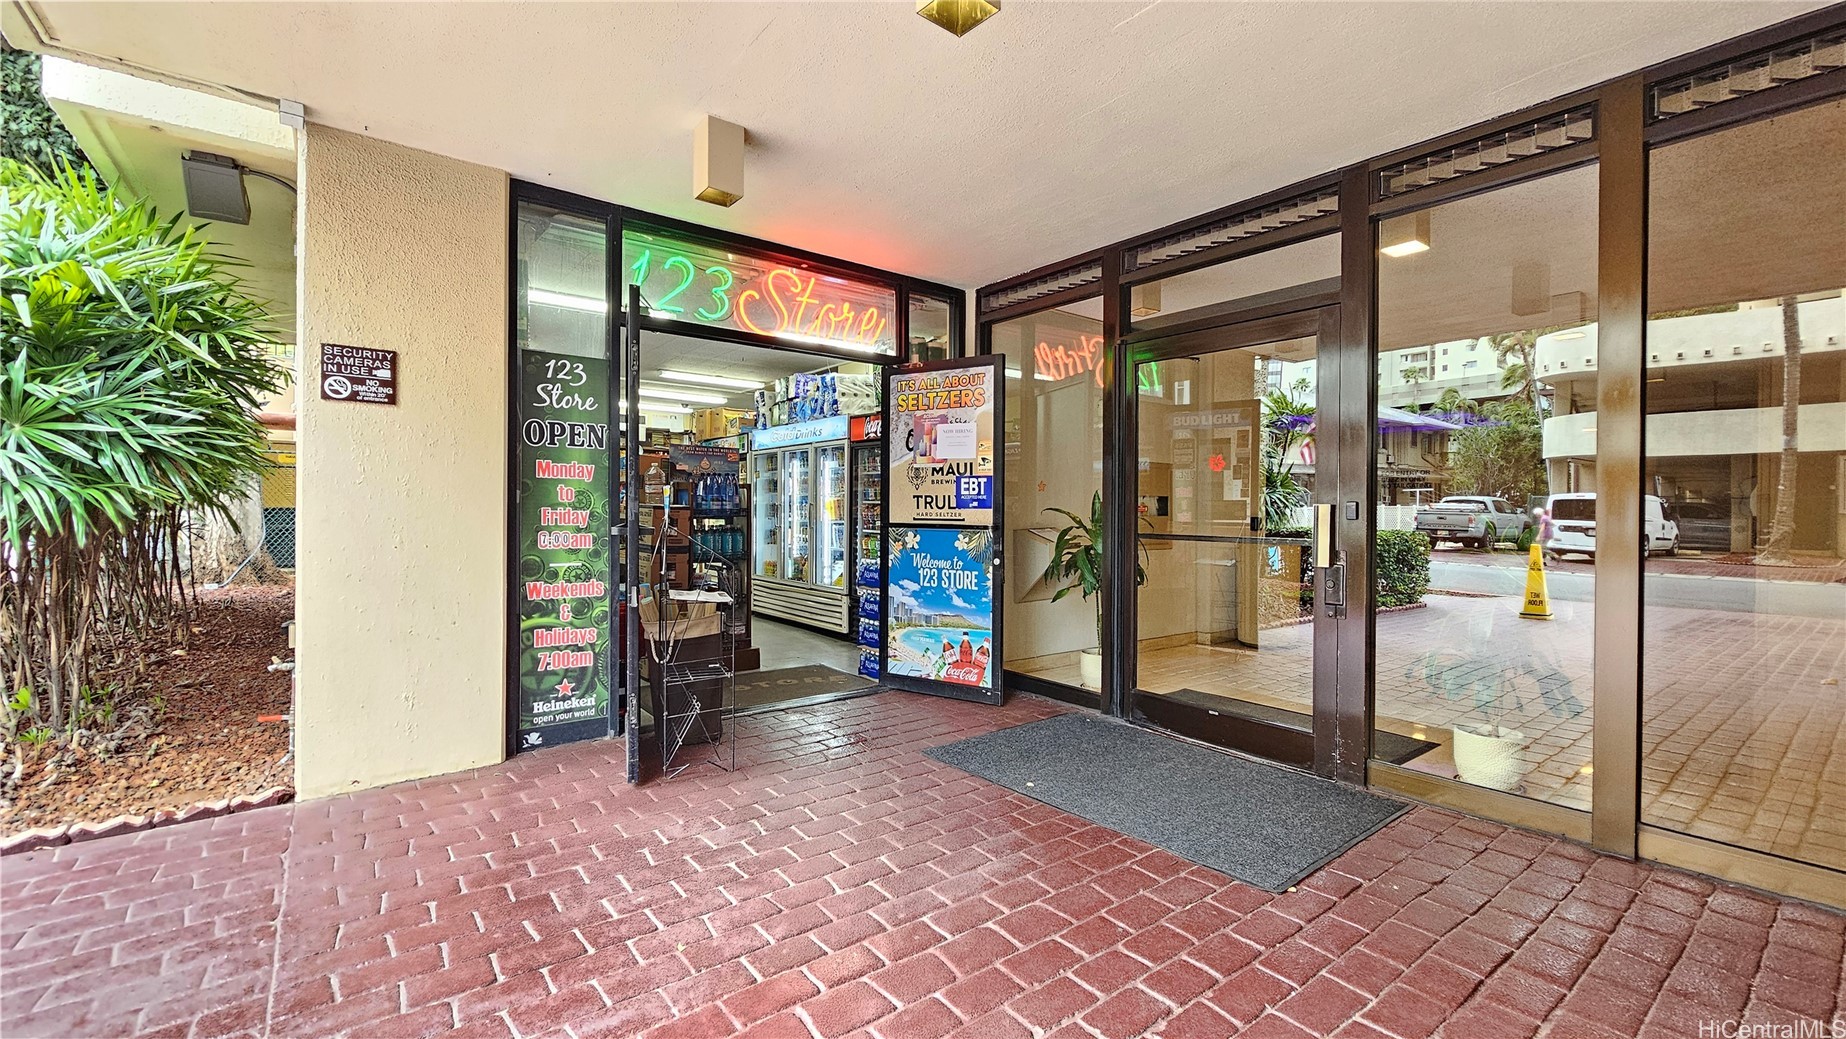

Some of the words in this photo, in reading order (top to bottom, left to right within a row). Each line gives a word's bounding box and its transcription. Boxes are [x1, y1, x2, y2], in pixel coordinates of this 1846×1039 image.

[631, 250, 733, 320] 123
[739, 269, 886, 346] Store
[323, 345, 393, 361] SECURITY
[323, 355, 391, 369] CAMERAS
[323, 363, 337, 372] IN
[341, 365, 369, 375] USE
[545, 359, 587, 386] 123
[352, 385, 393, 394] SMOKING
[366, 379, 379, 387] NO
[897, 379, 915, 392] IT'S
[918, 377, 940, 391] ALL
[943, 373, 985, 388] ABOUT
[533, 383, 598, 411] Store
[897, 388, 986, 412] SELTZERS
[1174, 416, 1200, 426] BUD
[1201, 413, 1241, 425] LIGHT
[523, 418, 607, 449] OPEN
[536, 460, 595, 482] Monday
[931, 462, 973, 476] MAUI
[557, 484, 575, 502] to
[960, 477, 987, 495] EBT
[913, 494, 957, 510] TRUL
[541, 507, 590, 527] Friday
[910, 552, 953, 570] Welcome
[953, 556, 964, 570] to
[918, 568, 938, 588] 123
[942, 570, 979, 591] STORE
[526, 579, 605, 600] Weekends
[559, 604, 571, 622] &
[533, 627, 597, 648] Holidays
[537, 650, 593, 671] 7:00am
[532, 695, 595, 714] Heineken
[533, 714, 554, 725] open
[555, 711, 572, 723] your
[574, 707, 595, 718] world
